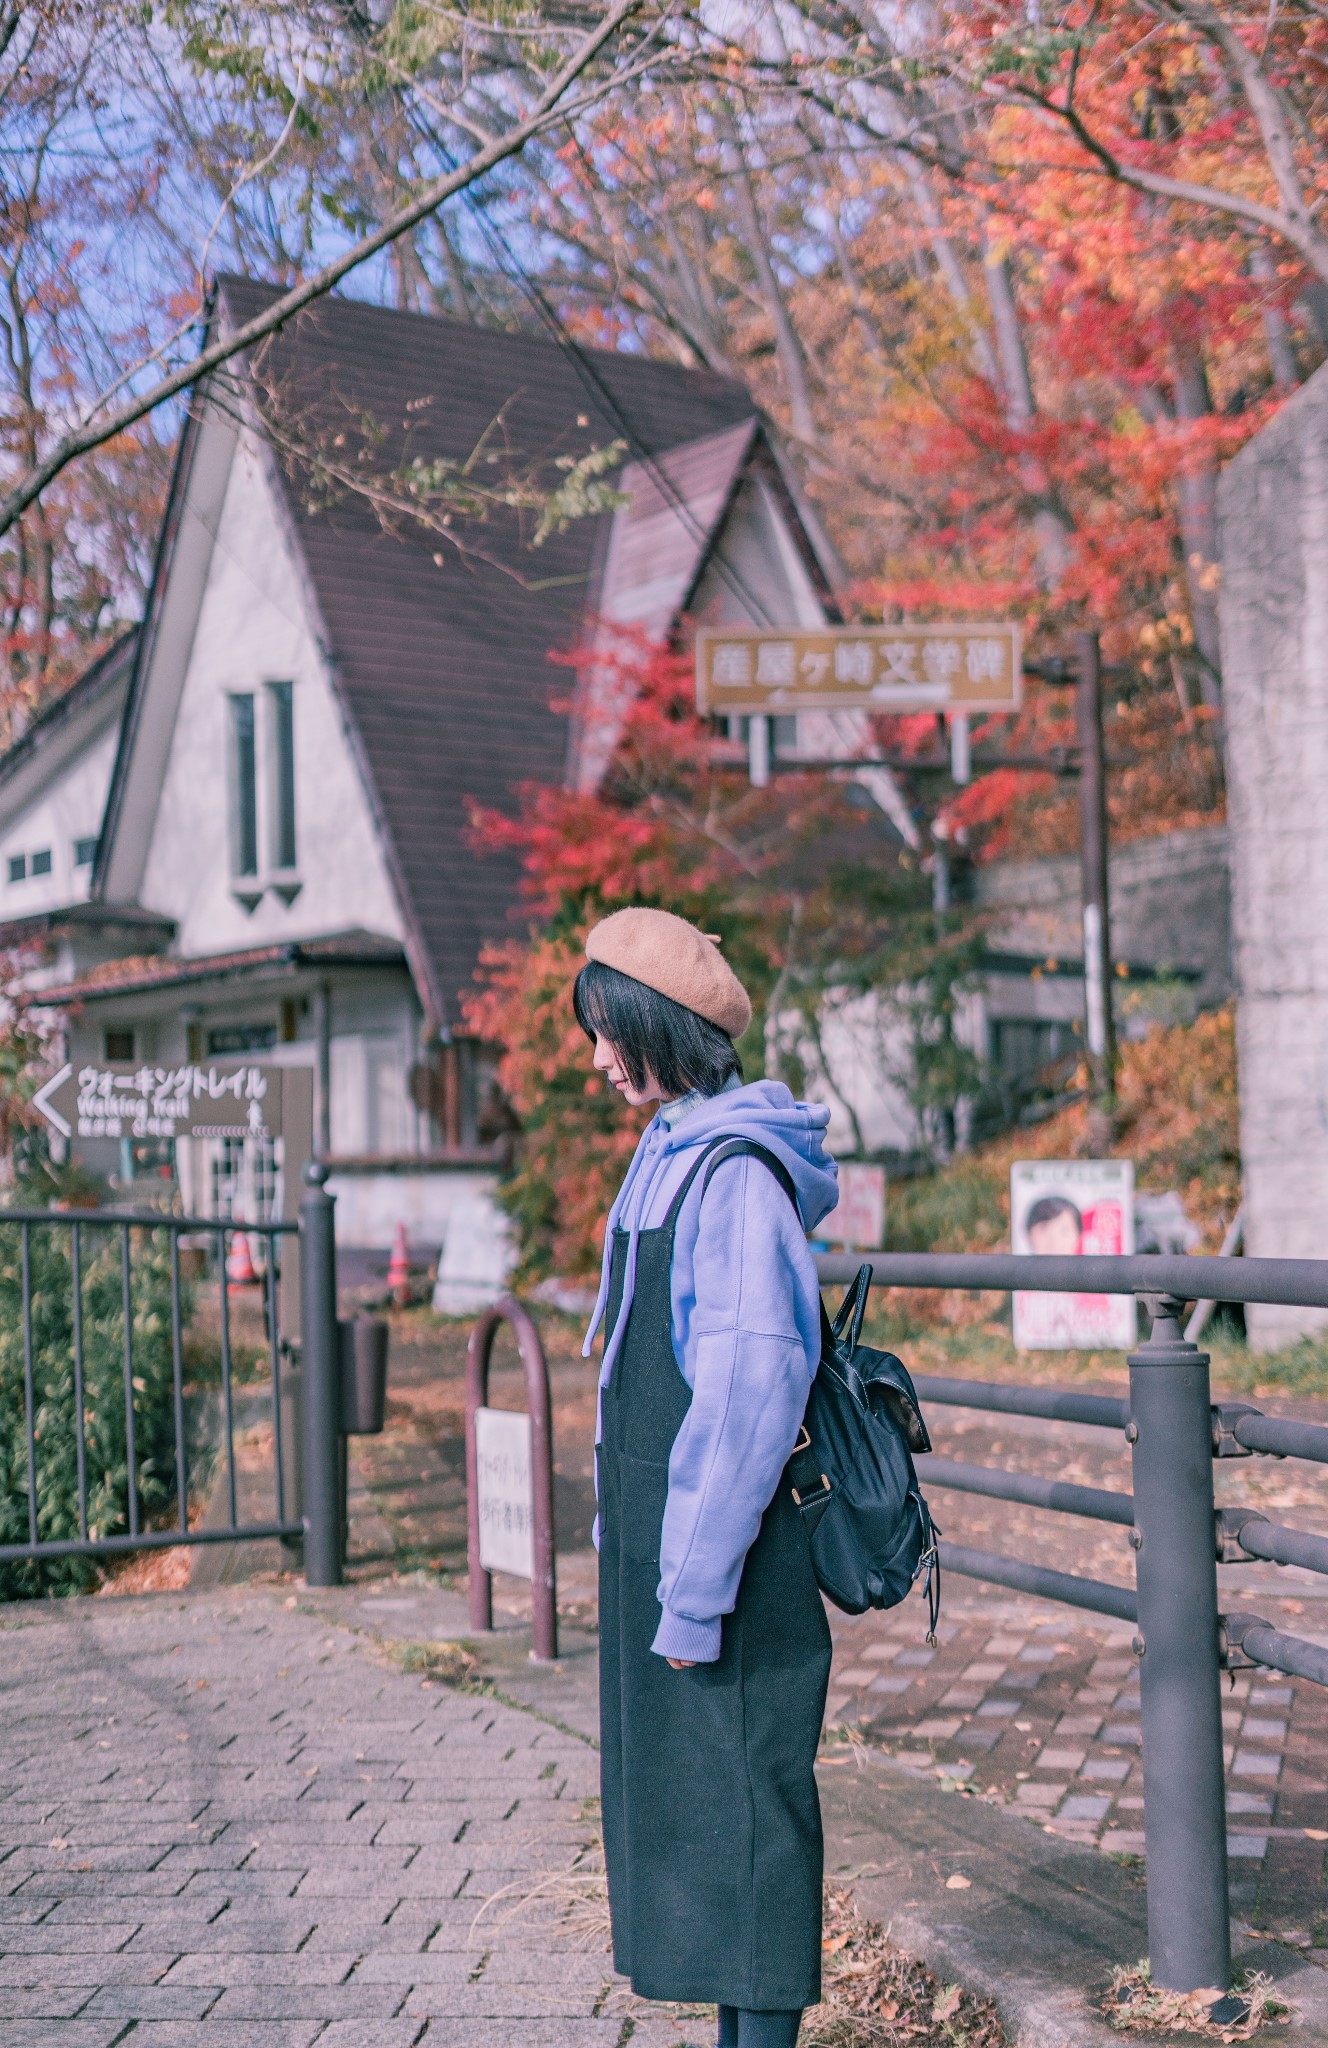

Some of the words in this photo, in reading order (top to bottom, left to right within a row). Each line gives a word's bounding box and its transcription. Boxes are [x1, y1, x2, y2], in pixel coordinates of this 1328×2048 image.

[78, 1066, 267, 1099] ウォーキングトレイル
[77, 1095, 148, 1121] Walking
[151, 1095, 189, 1119] Trail
